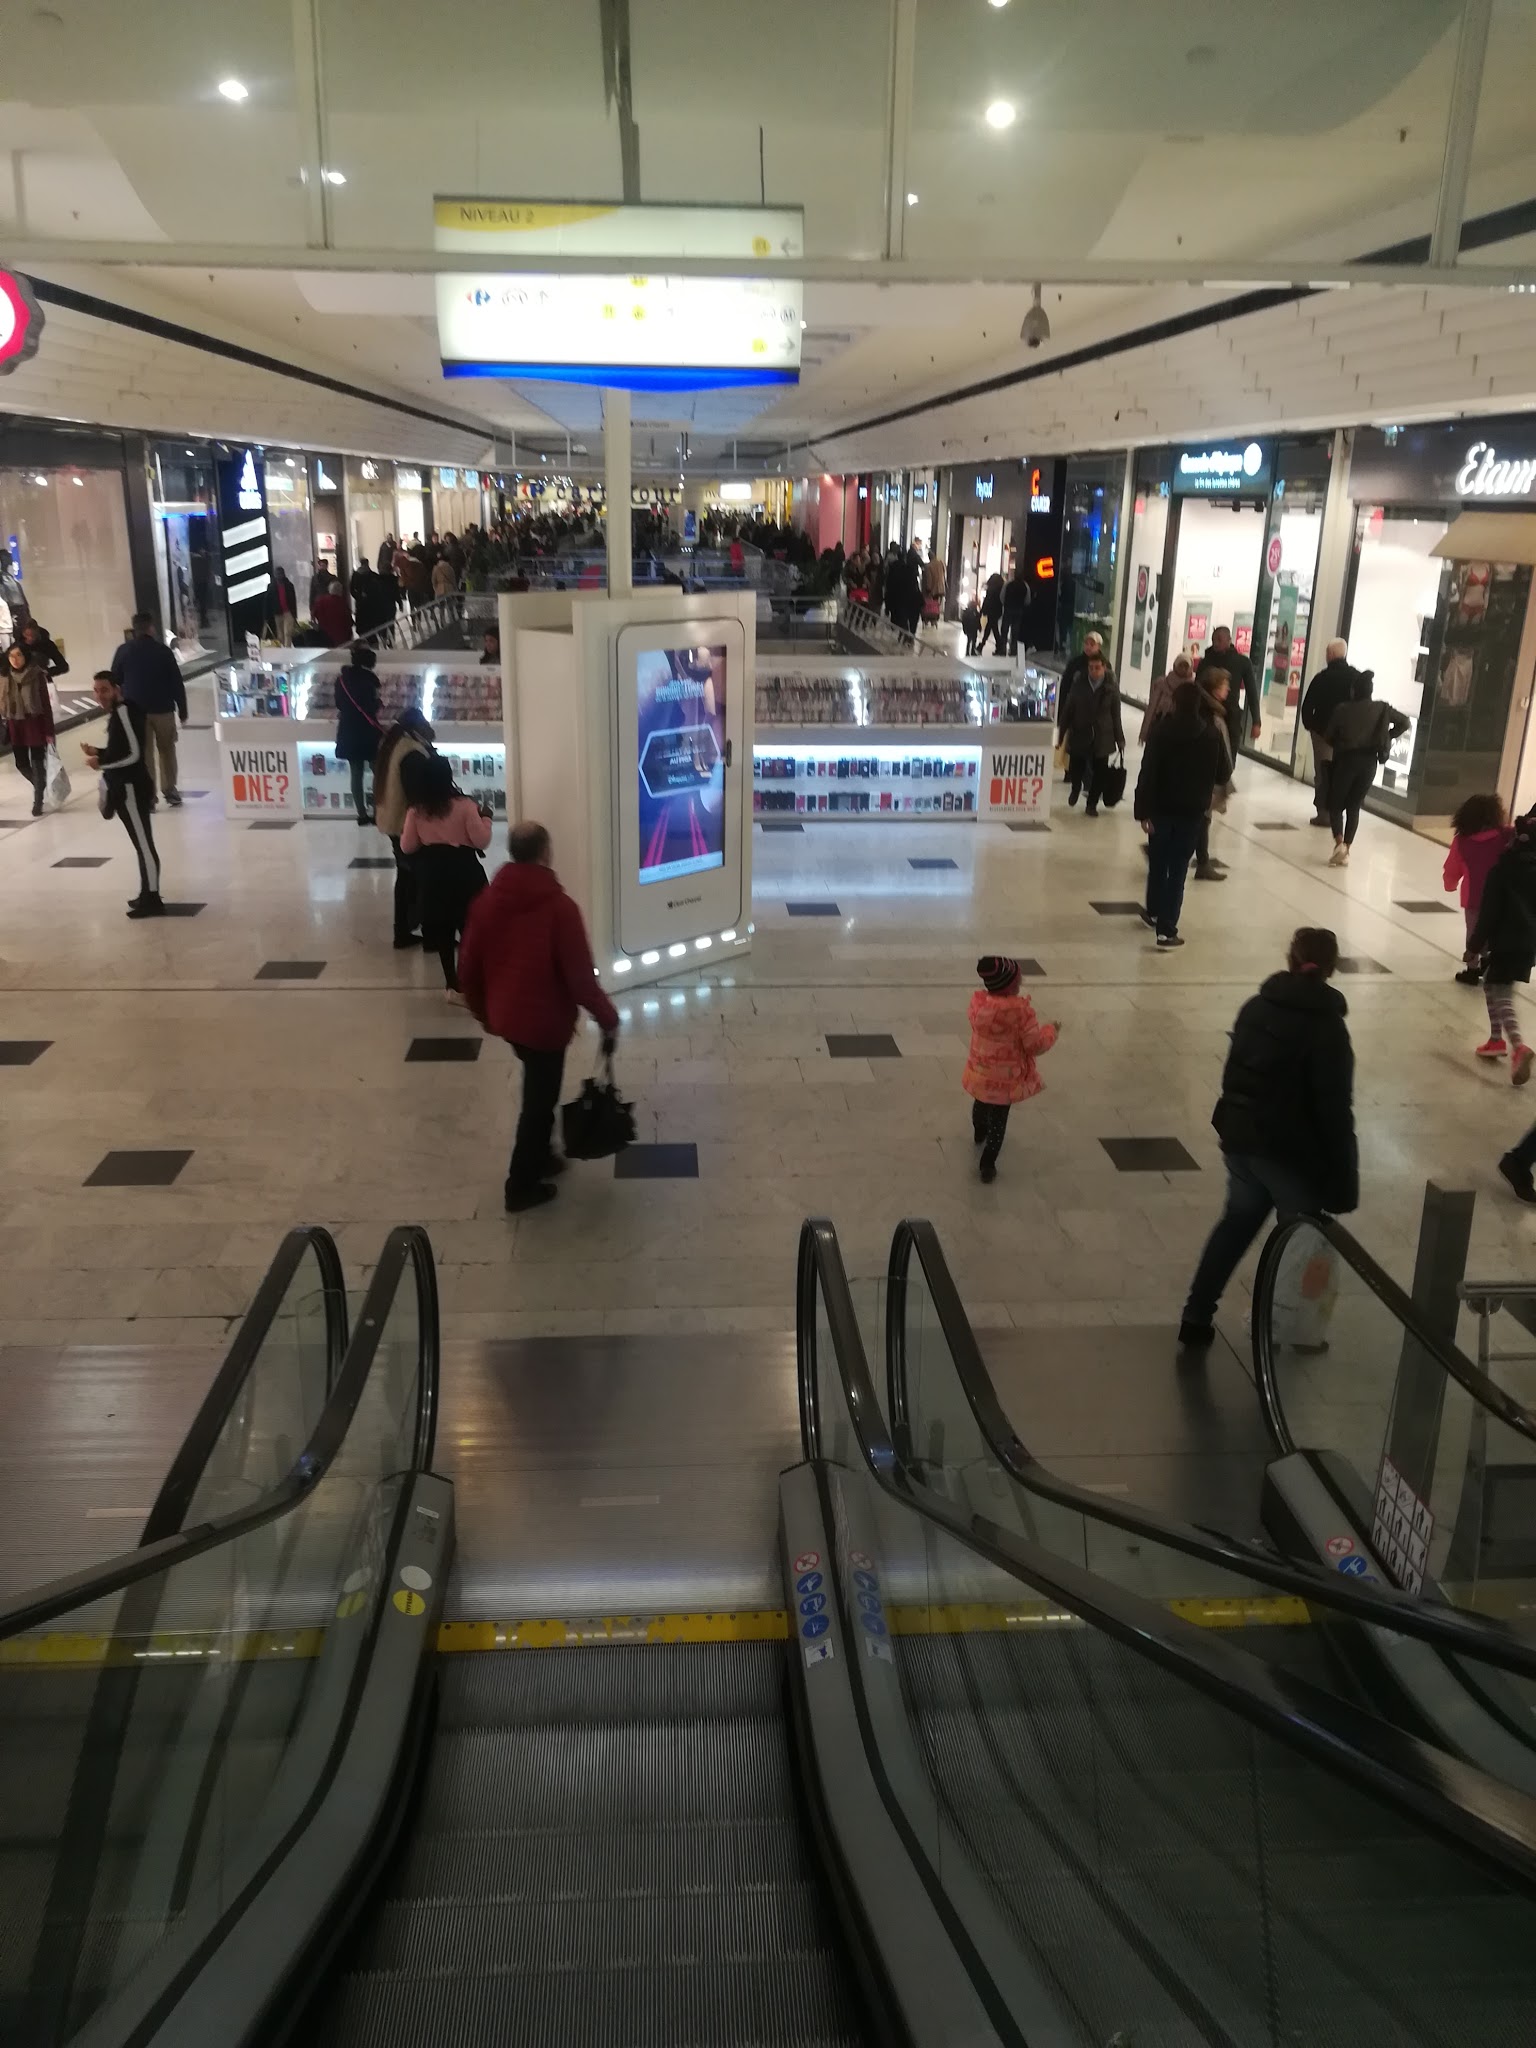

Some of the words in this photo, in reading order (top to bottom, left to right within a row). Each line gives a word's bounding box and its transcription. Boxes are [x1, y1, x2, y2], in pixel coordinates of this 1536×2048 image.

[460, 207, 520, 224] NIVEAU
[229, 750, 289, 774] WHICH
[992, 753, 1046, 777] WHICH
